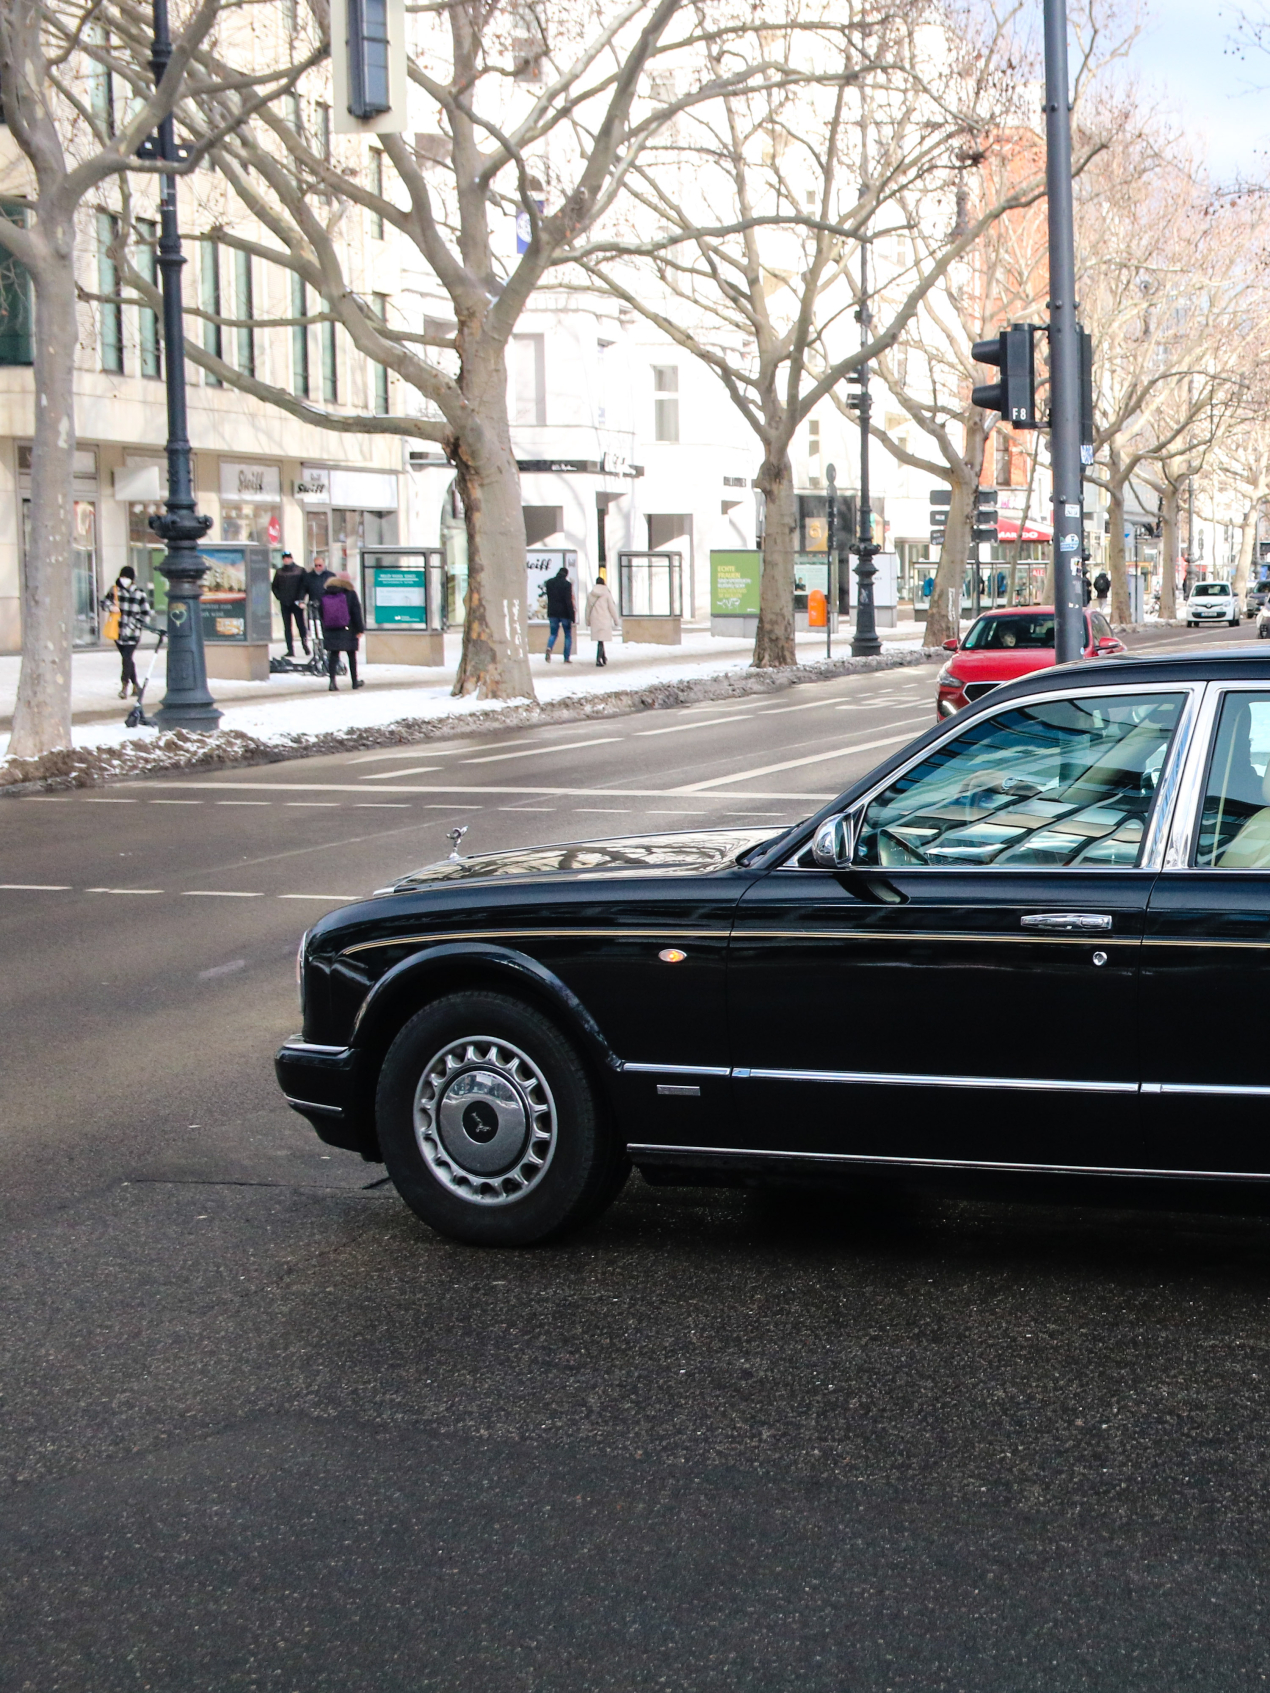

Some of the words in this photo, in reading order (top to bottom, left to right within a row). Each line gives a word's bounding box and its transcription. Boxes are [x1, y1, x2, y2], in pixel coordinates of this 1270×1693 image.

[238, 469, 265, 494] Steiff
[296, 483, 326, 495] Steiff
[998, 531, 1039, 539] MARDO
